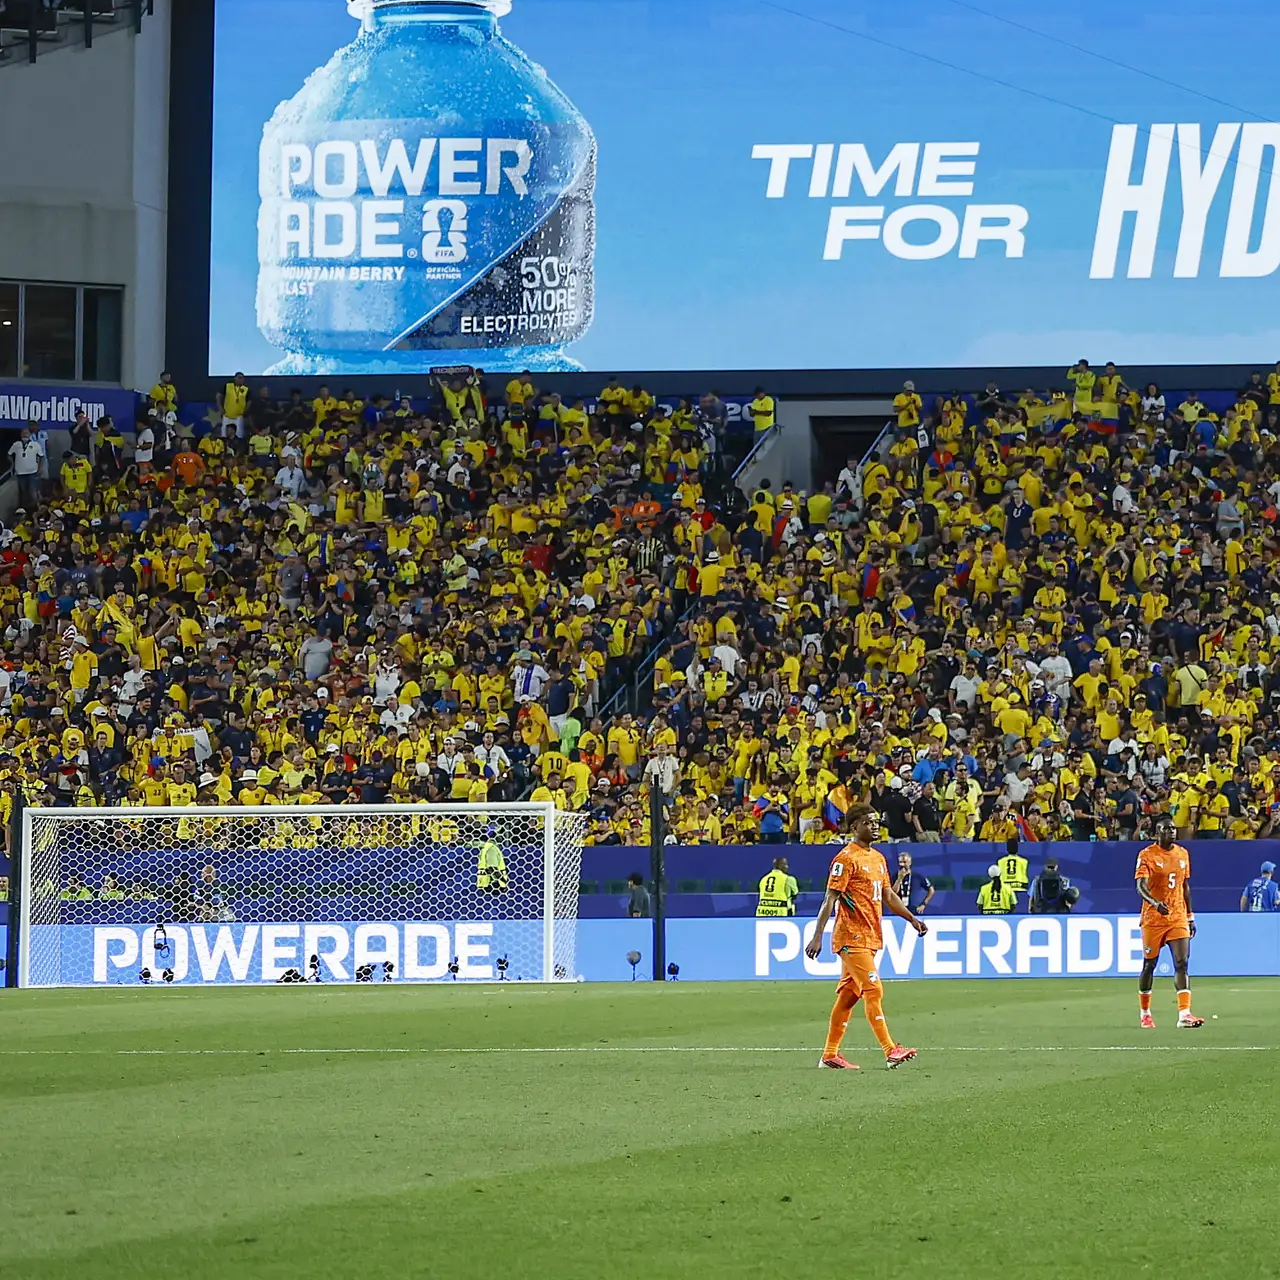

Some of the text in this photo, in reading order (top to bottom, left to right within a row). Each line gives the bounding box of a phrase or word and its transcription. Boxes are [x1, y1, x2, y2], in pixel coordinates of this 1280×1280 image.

[280, 138, 534, 200] POWER
[750, 141, 981, 199] TIME
[280, 200, 404, 259] ADE
[823, 204, 1029, 261] FOR
[349, 266, 405, 281] BERRY
[425, 272, 462, 280] PARTNER
[520, 256, 577, 289] 50%
[523, 288, 576, 314] MORE
[460, 312, 578, 334] ELECTROLYTES
[549, 757, 562, 770] 10
[1167, 873, 1176, 889] 5
[93, 922, 494, 983] POWERADE
